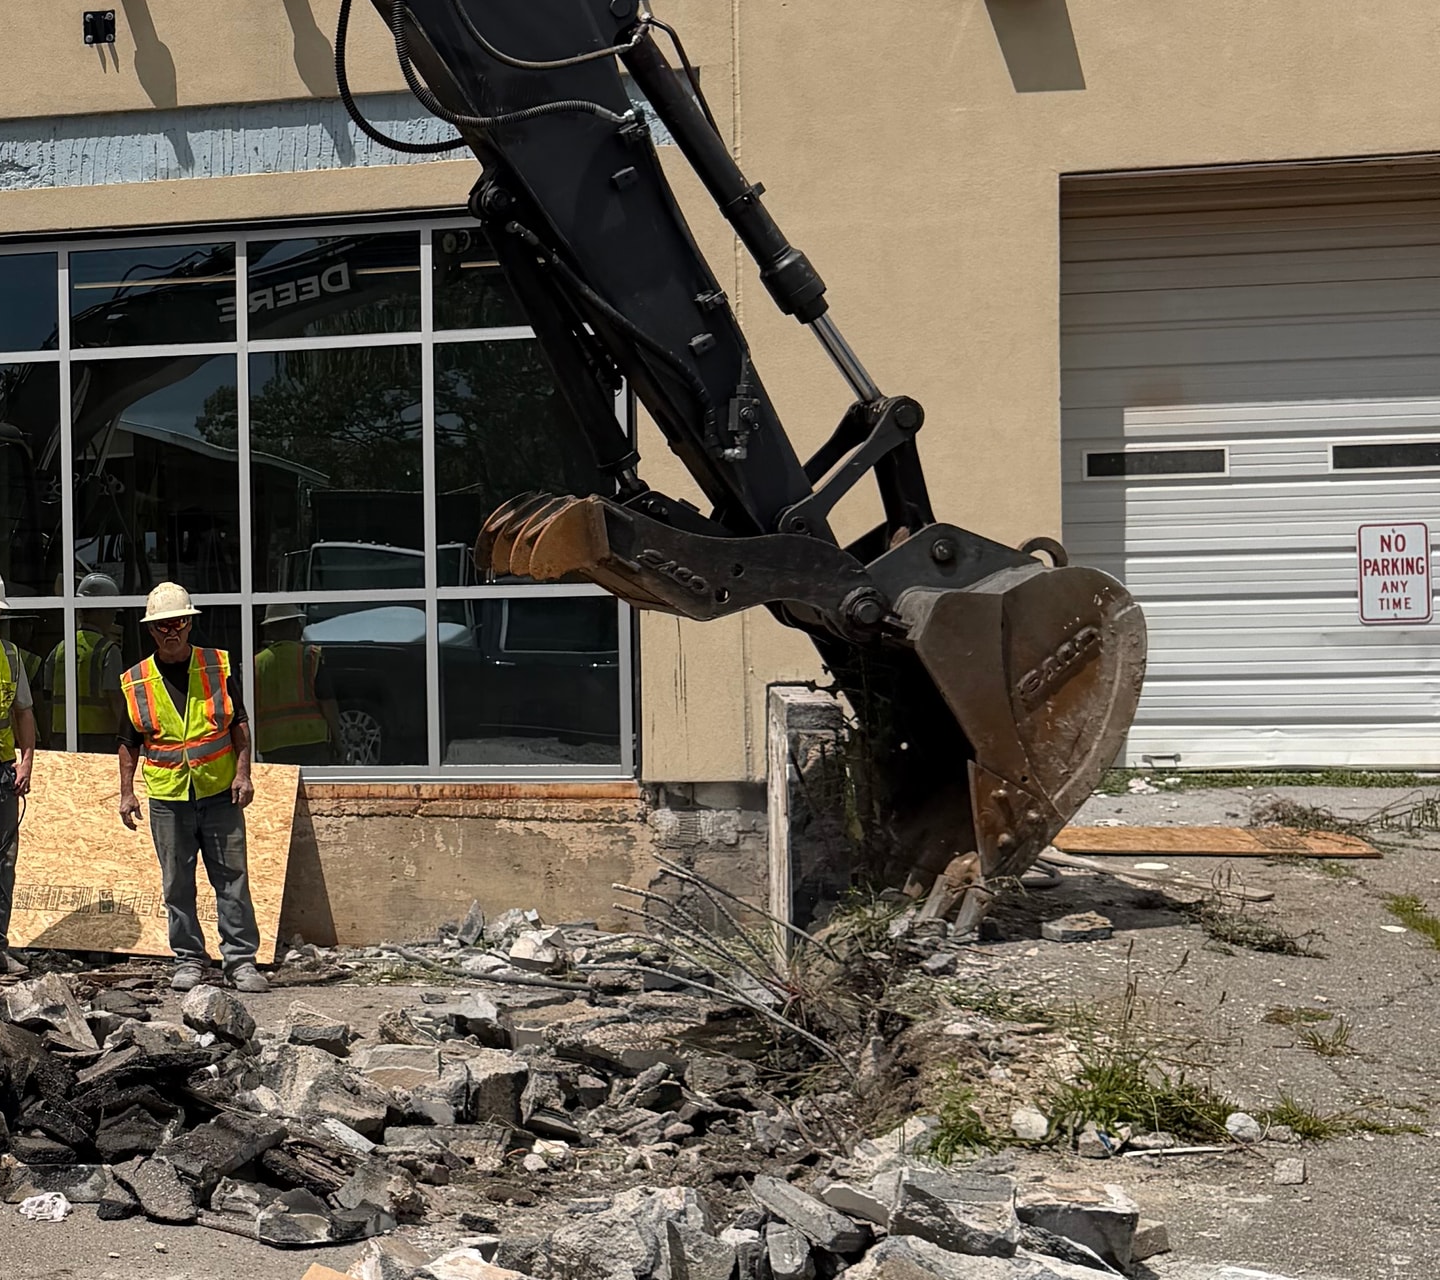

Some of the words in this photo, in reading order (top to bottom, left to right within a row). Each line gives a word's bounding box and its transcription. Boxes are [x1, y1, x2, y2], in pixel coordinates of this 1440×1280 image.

[1380, 534, 1406, 553] NO
[1363, 556, 1425, 577] PARKING
[1380, 580, 1409, 594] ANY
[1378, 596, 1413, 611] TIME
